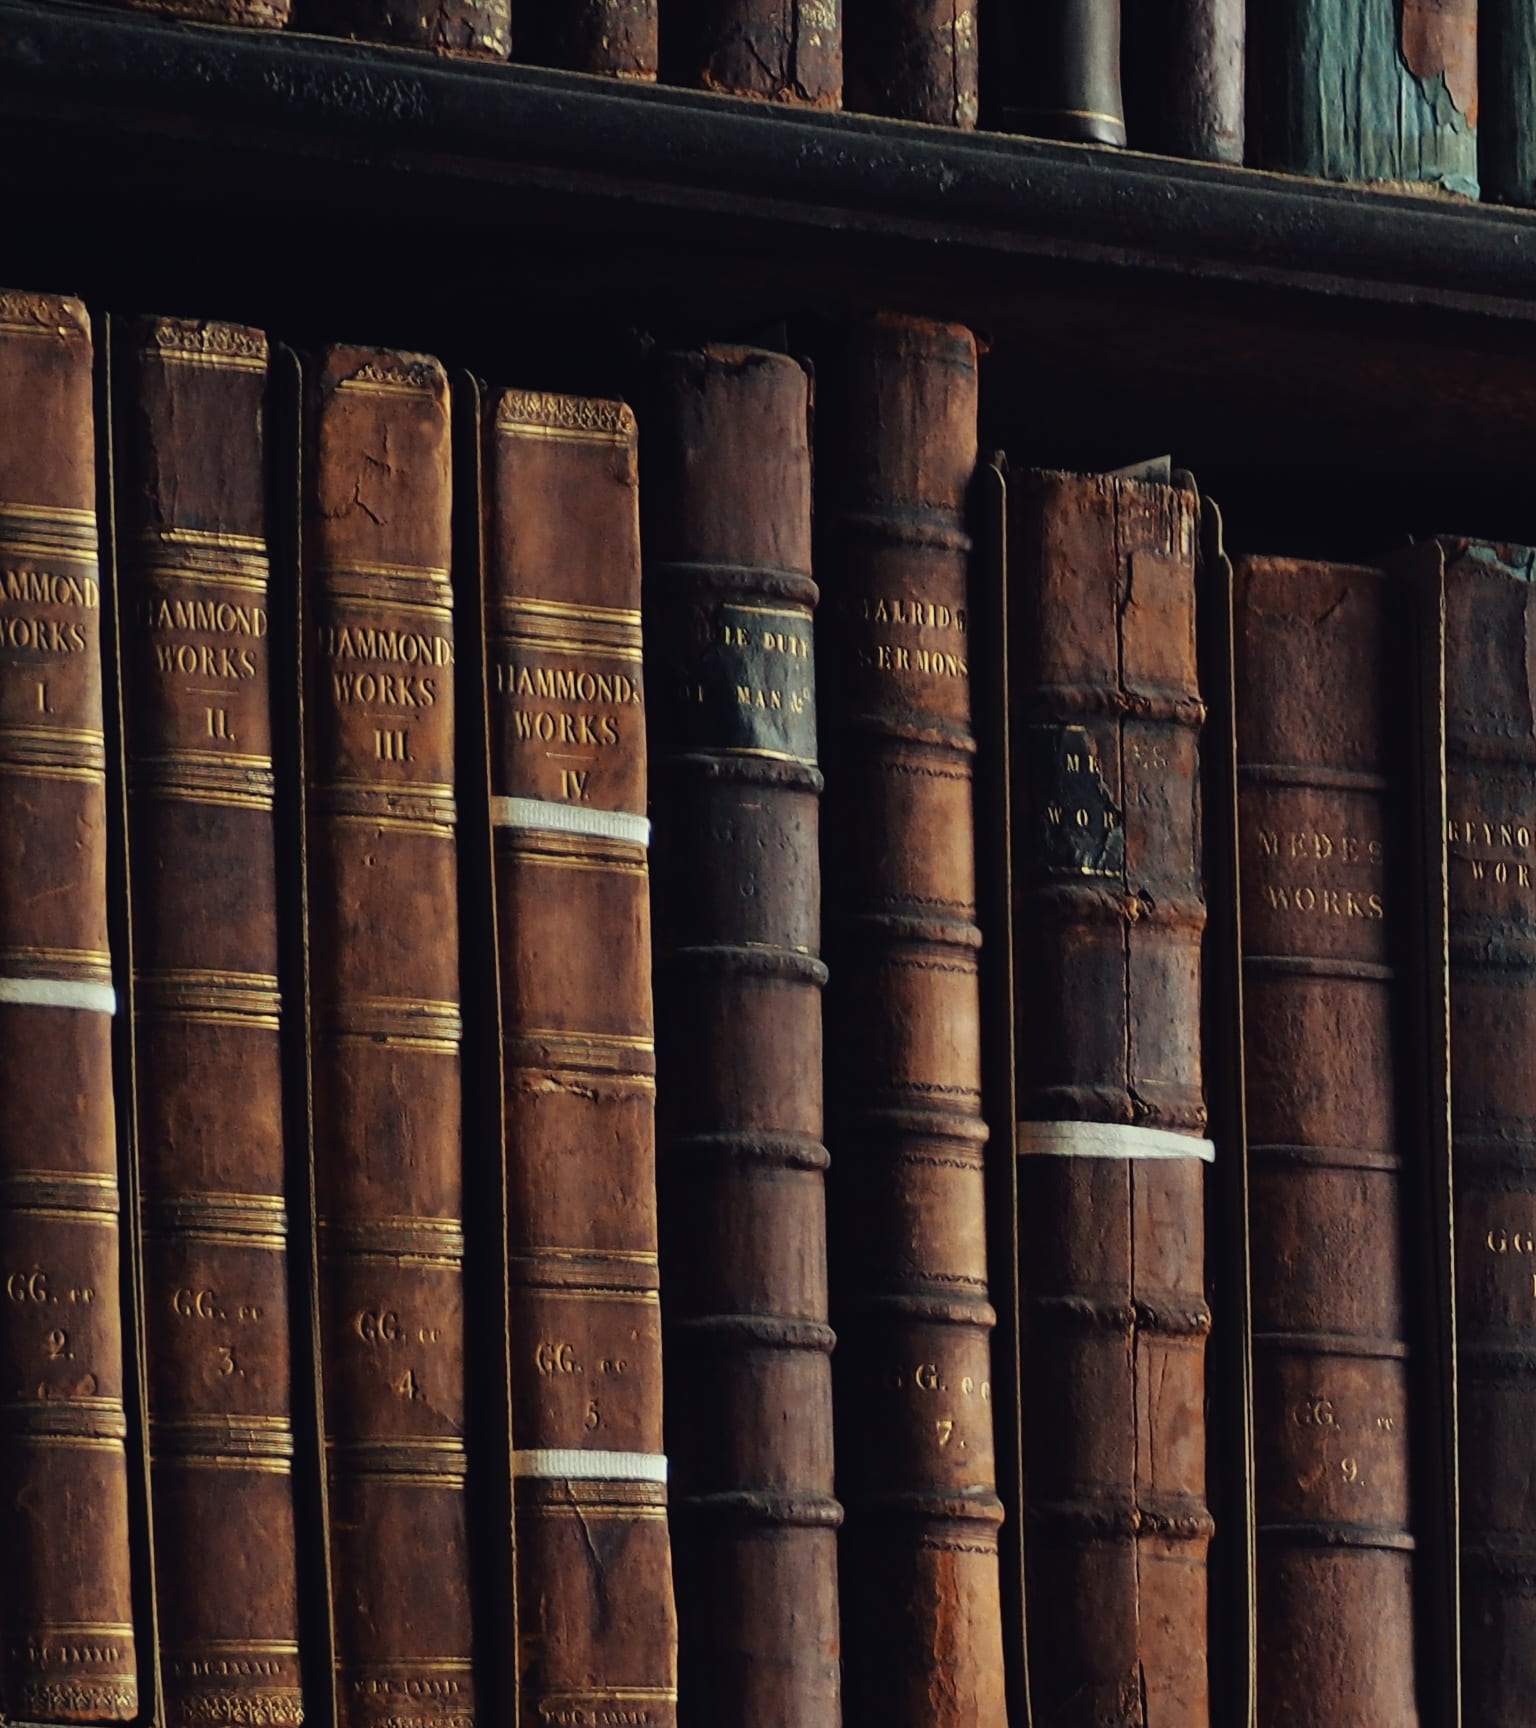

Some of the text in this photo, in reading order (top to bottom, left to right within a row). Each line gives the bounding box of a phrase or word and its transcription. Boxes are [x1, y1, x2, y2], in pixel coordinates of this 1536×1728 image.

[157, 643, 257, 680] WORKS
[333, 672, 437, 708] WORKS
[204, 706, 236, 741] II.
[514, 710, 620, 746] WORKS
[373, 728, 415, 762] III.
[1258, 830, 1385, 869] MEDES
[1268, 884, 1385, 920] WORKS
